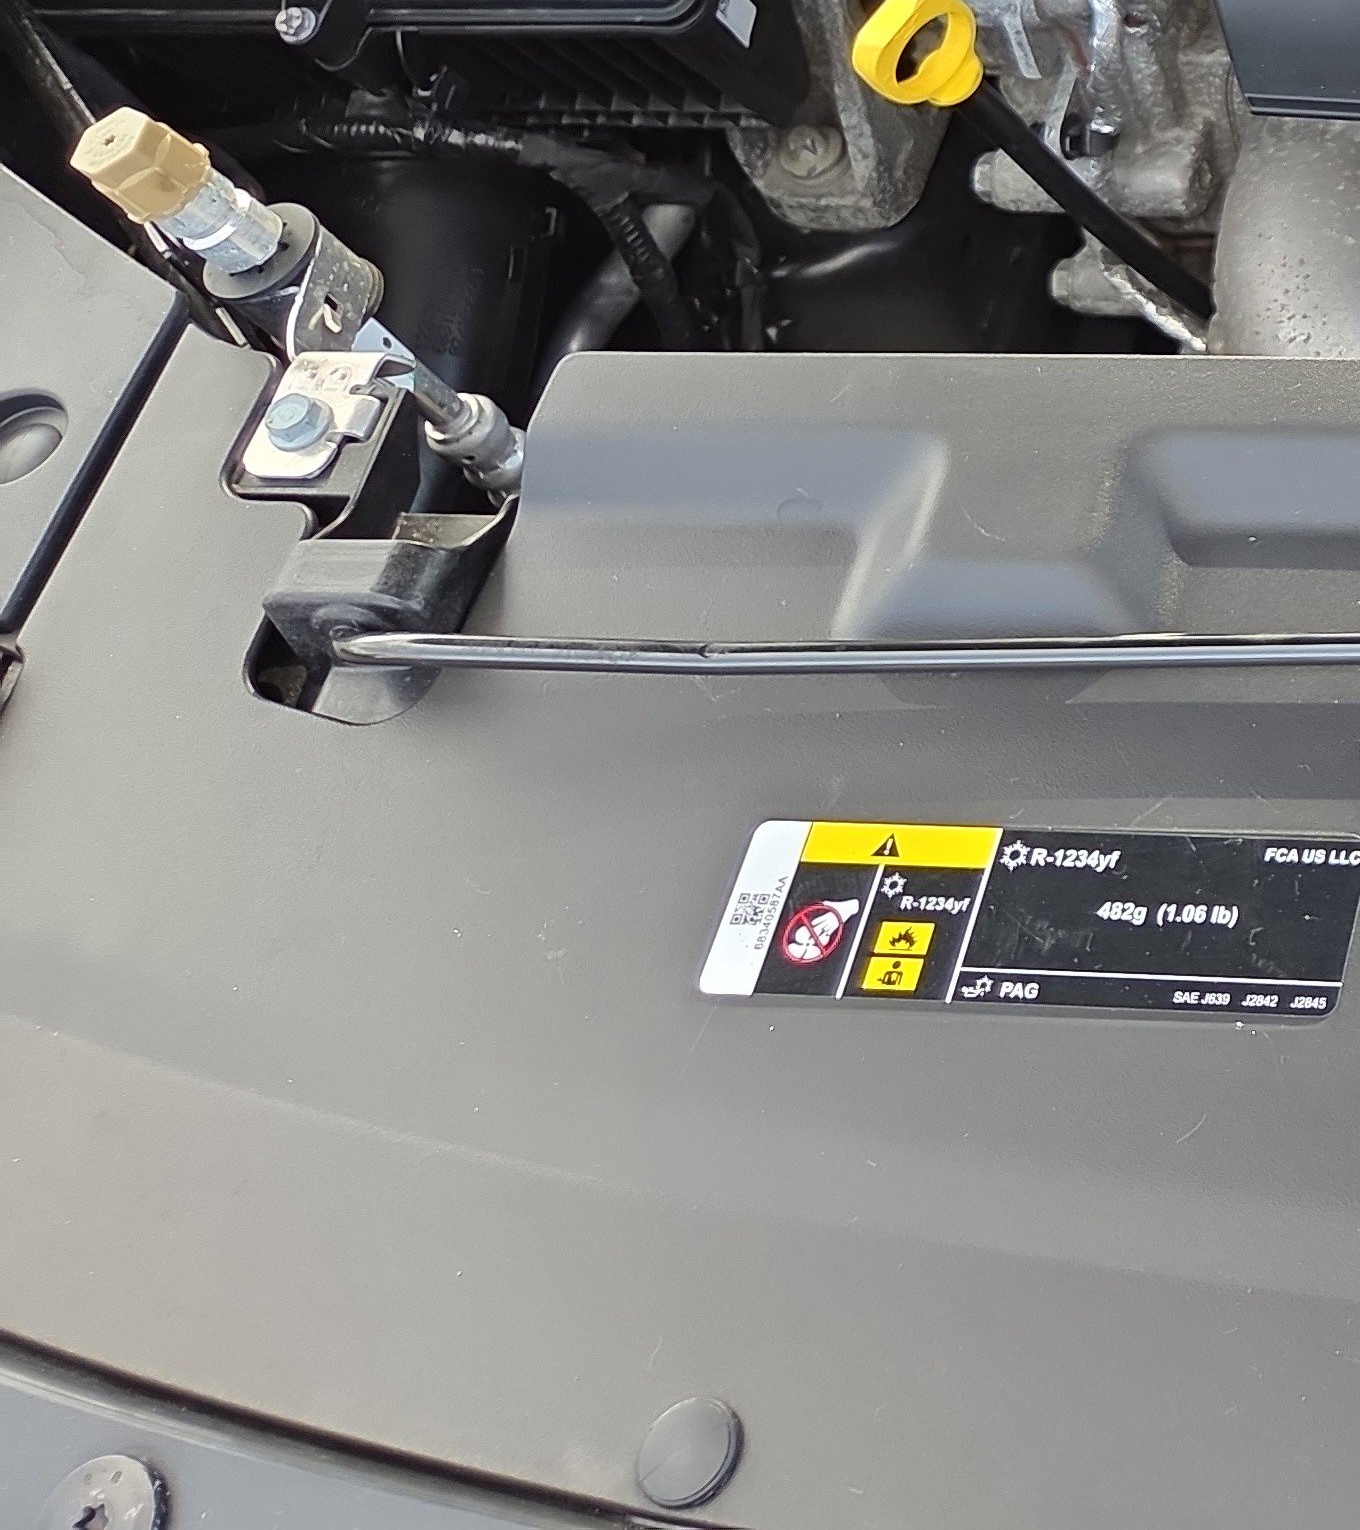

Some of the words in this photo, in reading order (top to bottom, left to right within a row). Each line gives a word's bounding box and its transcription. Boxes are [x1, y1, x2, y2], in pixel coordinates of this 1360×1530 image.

[1030, 846, 1120, 870] R-1234yf
[1264, 847, 1300, 863] FCA
[1302, 848, 1327, 864] US
[900, 895, 971, 915] R-1234yf
[1097, 902, 1148, 926] 482g
[1156, 904, 1206, 927] (1.06
[1210, 906, 1240, 928] lb)
[1000, 981, 1039, 1000] PAG
[1172, 990, 1200, 1004] SAE
[1200, 991, 1231, 1006] J639
[1241, 993, 1278, 1007] J2842
[1289, 995, 1328, 1010] J2845
